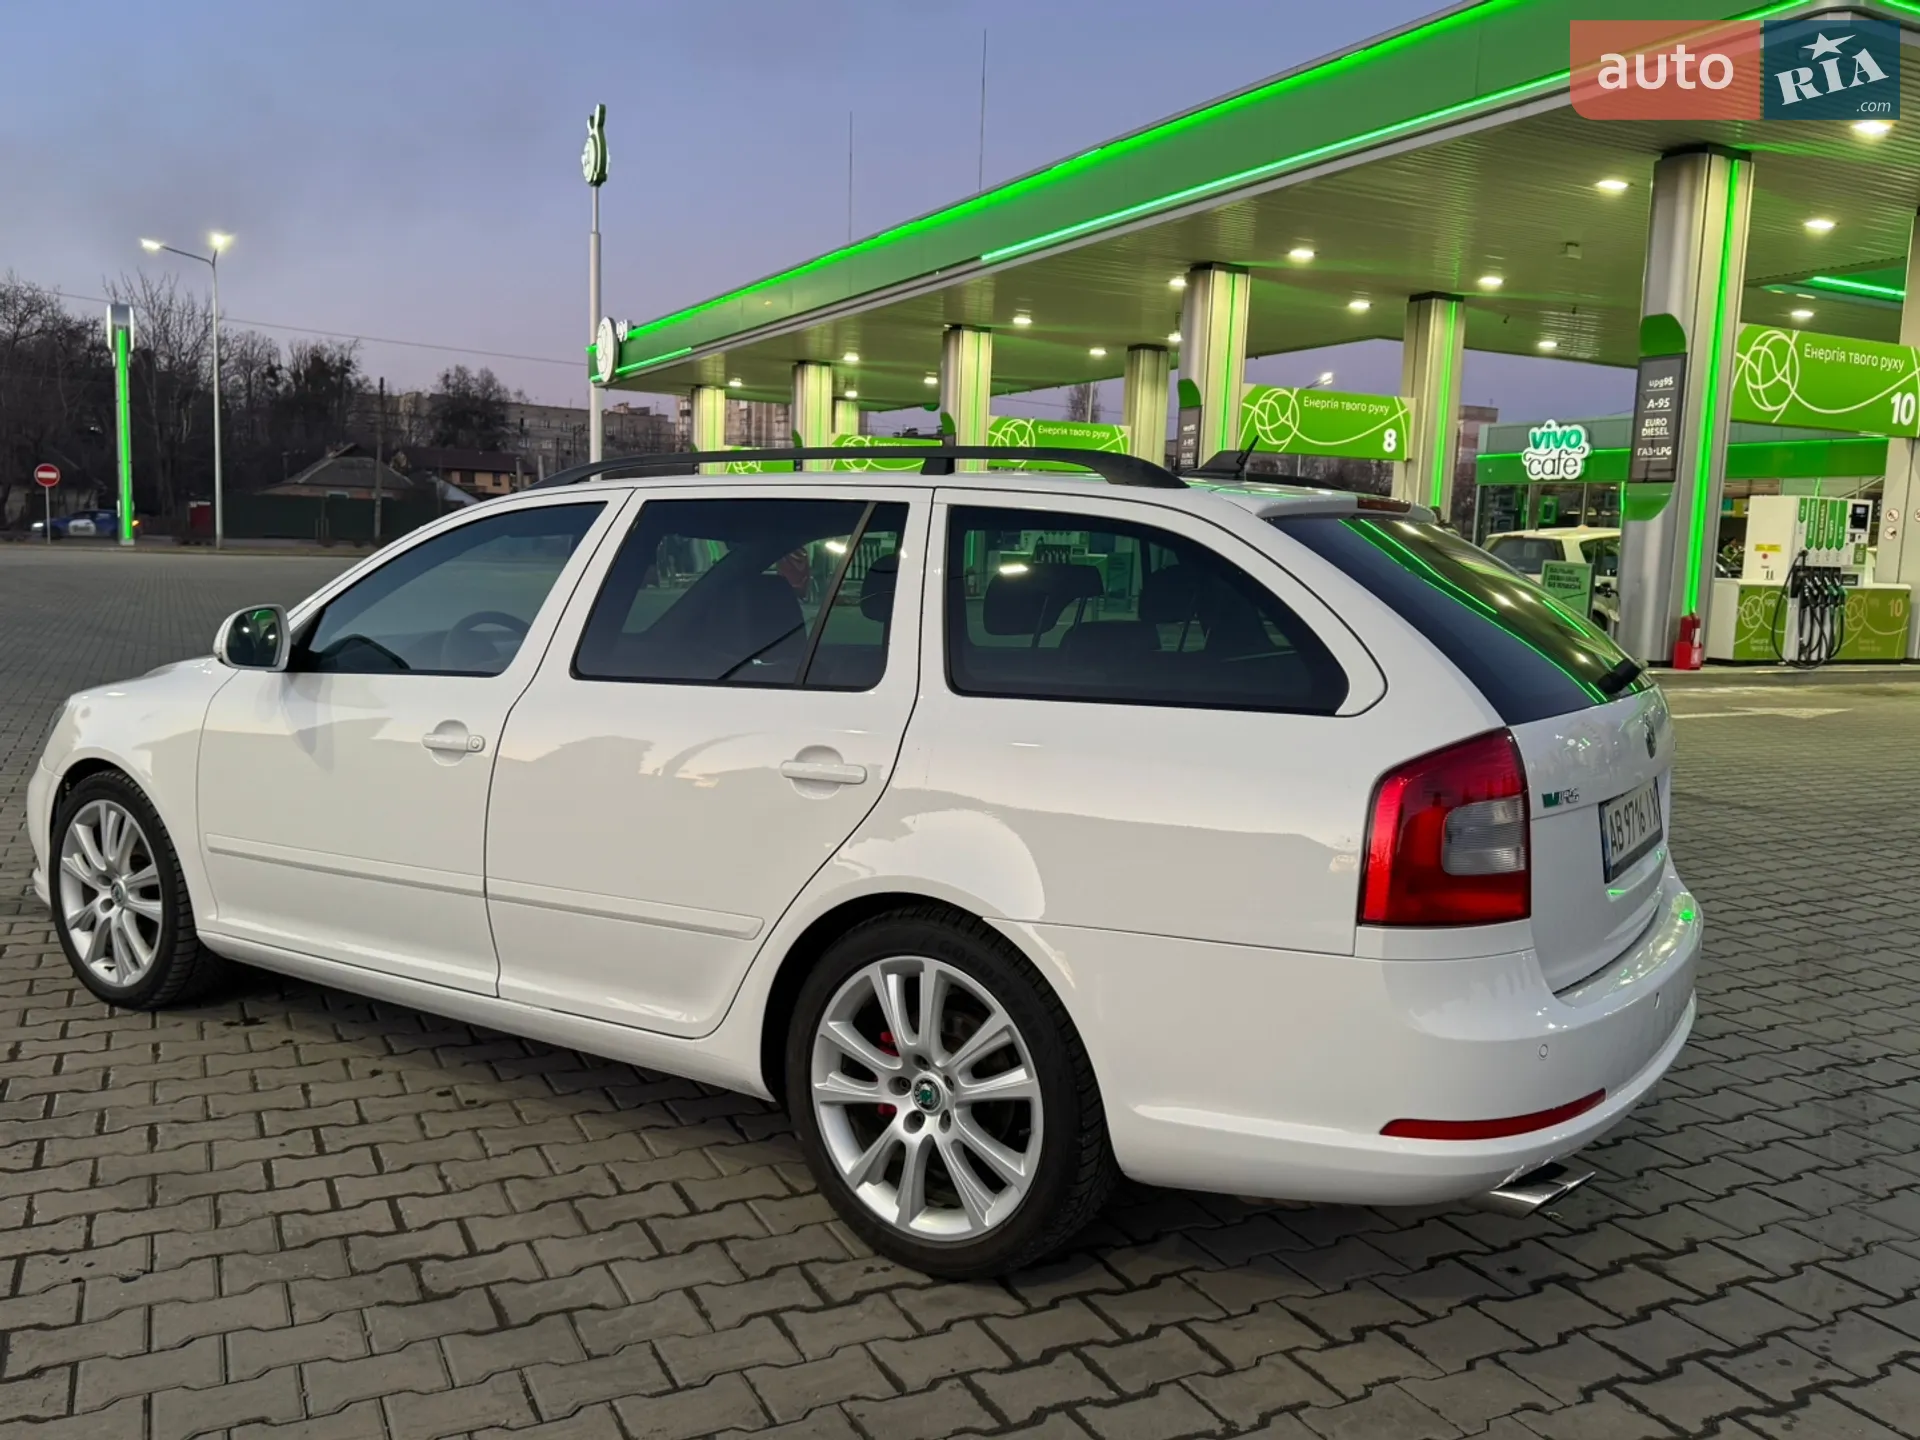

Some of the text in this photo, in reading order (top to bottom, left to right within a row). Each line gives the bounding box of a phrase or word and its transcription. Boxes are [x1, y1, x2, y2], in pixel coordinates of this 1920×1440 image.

[1804, 343, 1905, 373] Енергія твого руху
[1303, 396, 1390, 416] Енергія твого руху
[1890, 391, 1916, 426] 10
[1641, 427, 1669, 437] DIESEL
[1644, 417, 1668, 427] EURO
[1382, 428, 1397, 453] 8
[1530, 423, 1582, 450] vivo
[1888, 598, 1904, 617] 10
